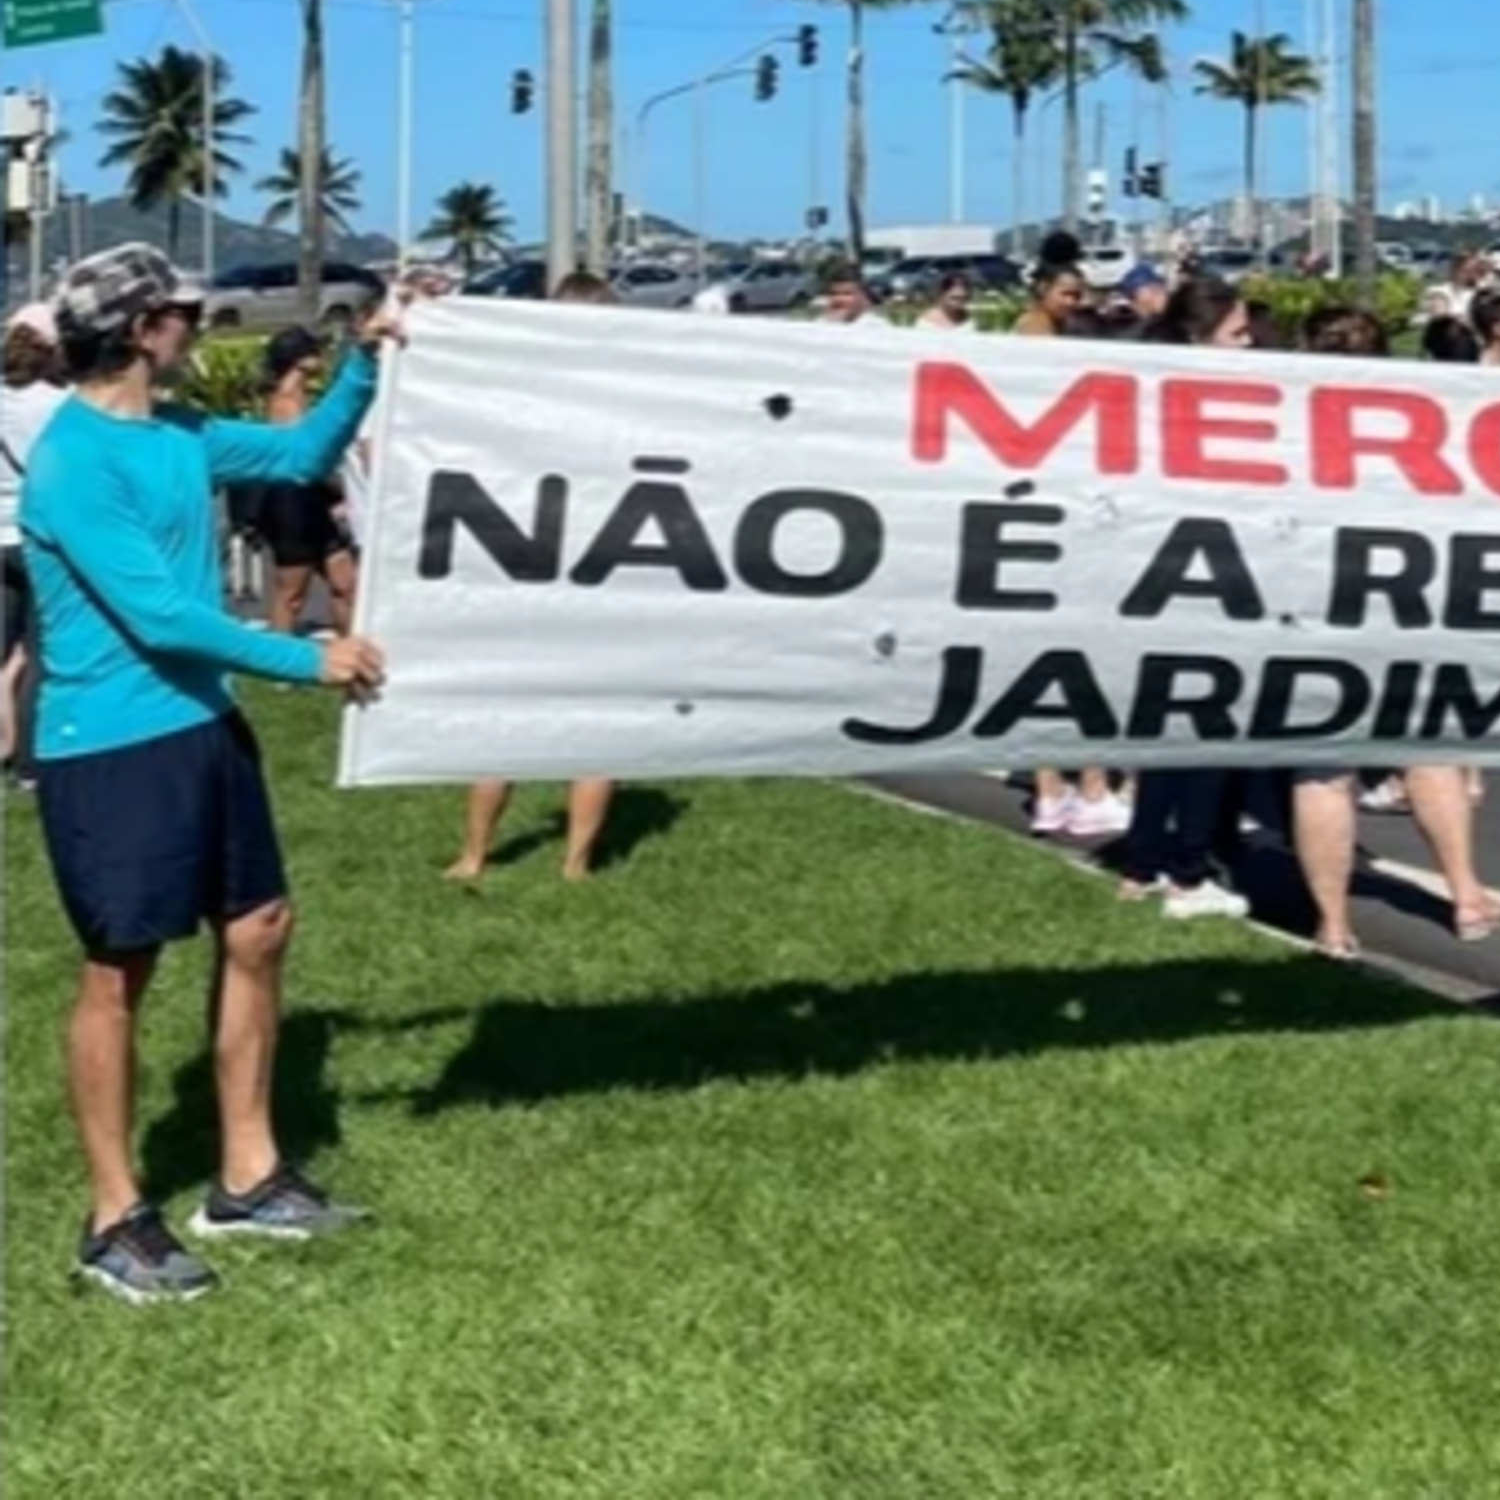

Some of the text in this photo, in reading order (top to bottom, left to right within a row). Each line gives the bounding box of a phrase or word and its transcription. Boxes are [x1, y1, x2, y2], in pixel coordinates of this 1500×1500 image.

[417, 454, 886, 598] NÃO
[954, 479, 1066, 611] É
[1118, 516, 1266, 621] A
